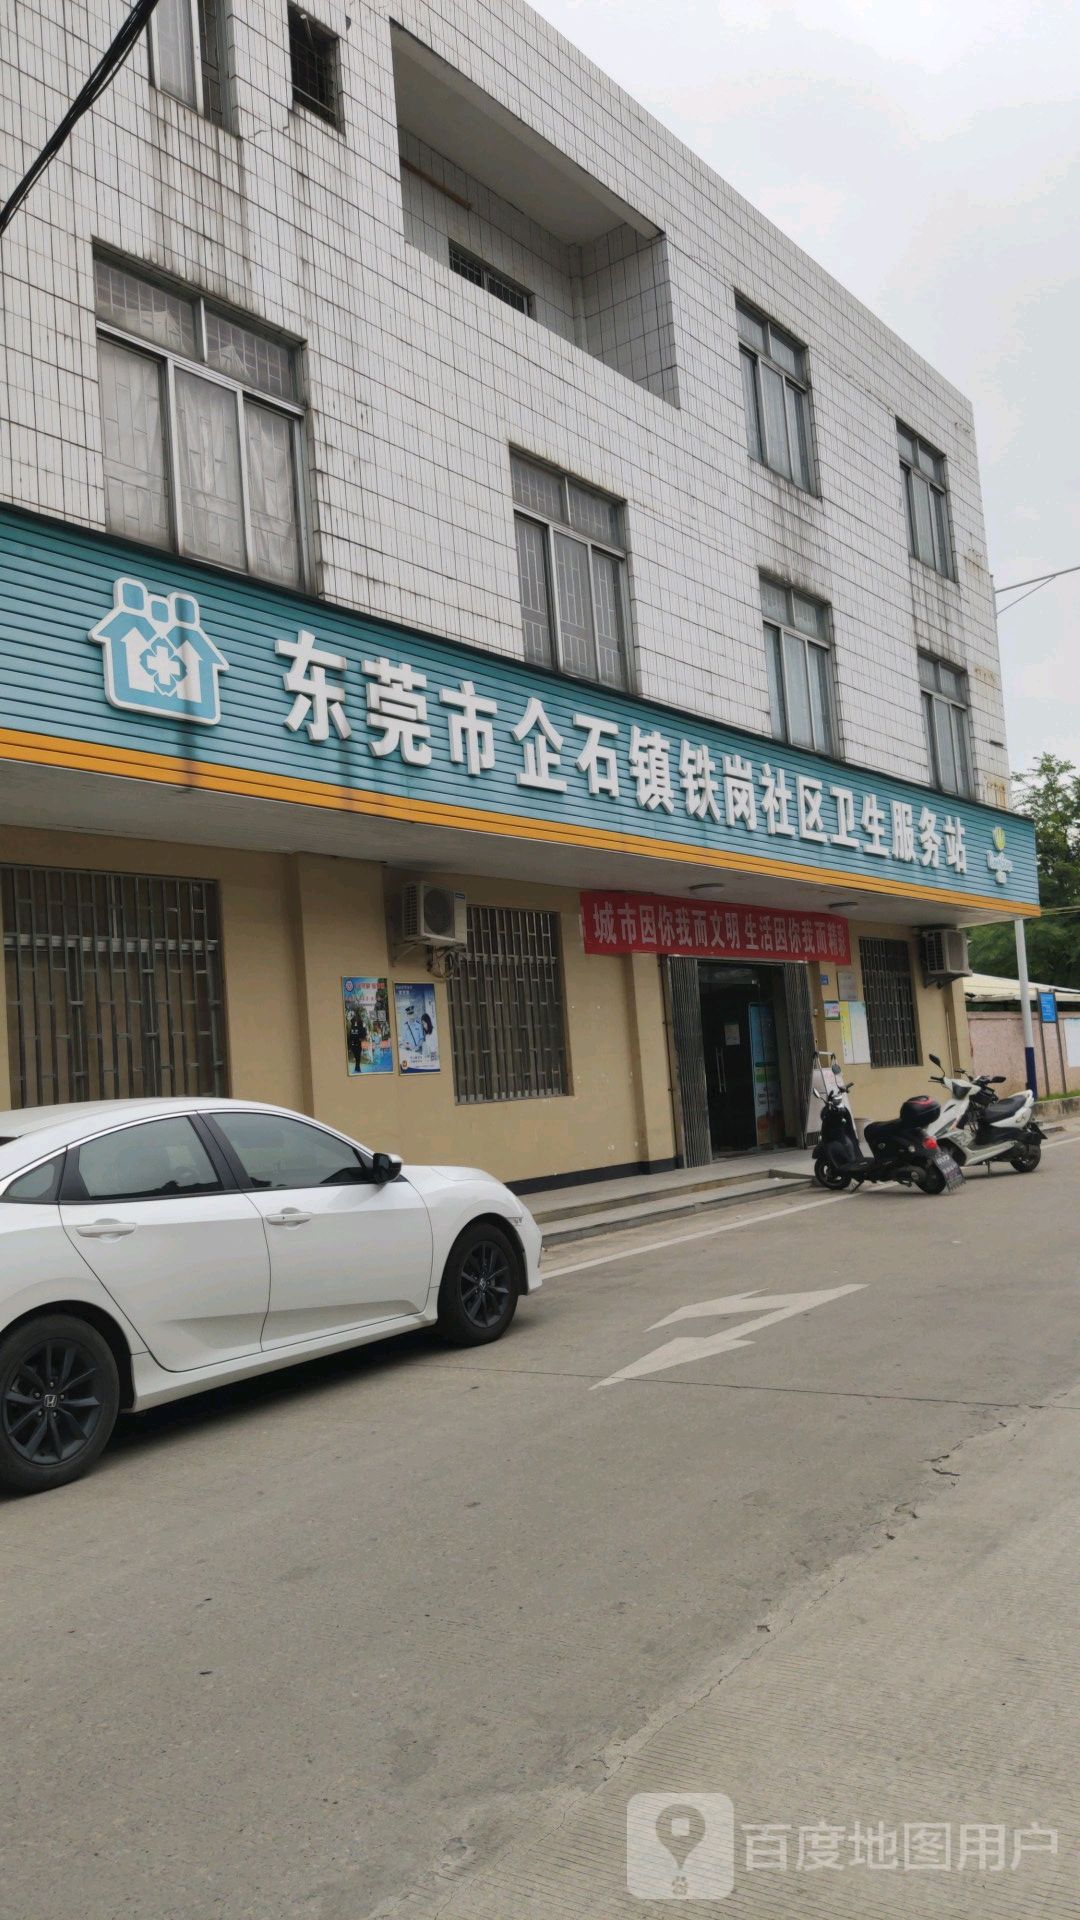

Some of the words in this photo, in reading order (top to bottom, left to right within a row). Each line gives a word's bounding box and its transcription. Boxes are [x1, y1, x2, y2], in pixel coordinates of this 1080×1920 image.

[274, 630, 967, 873] 东莞市企石镇铁岗社区卫生服务站
[593, 902, 740, 949] 城市因你我而文明
[745, 913, 846, 957] 生活因你我而精彩
